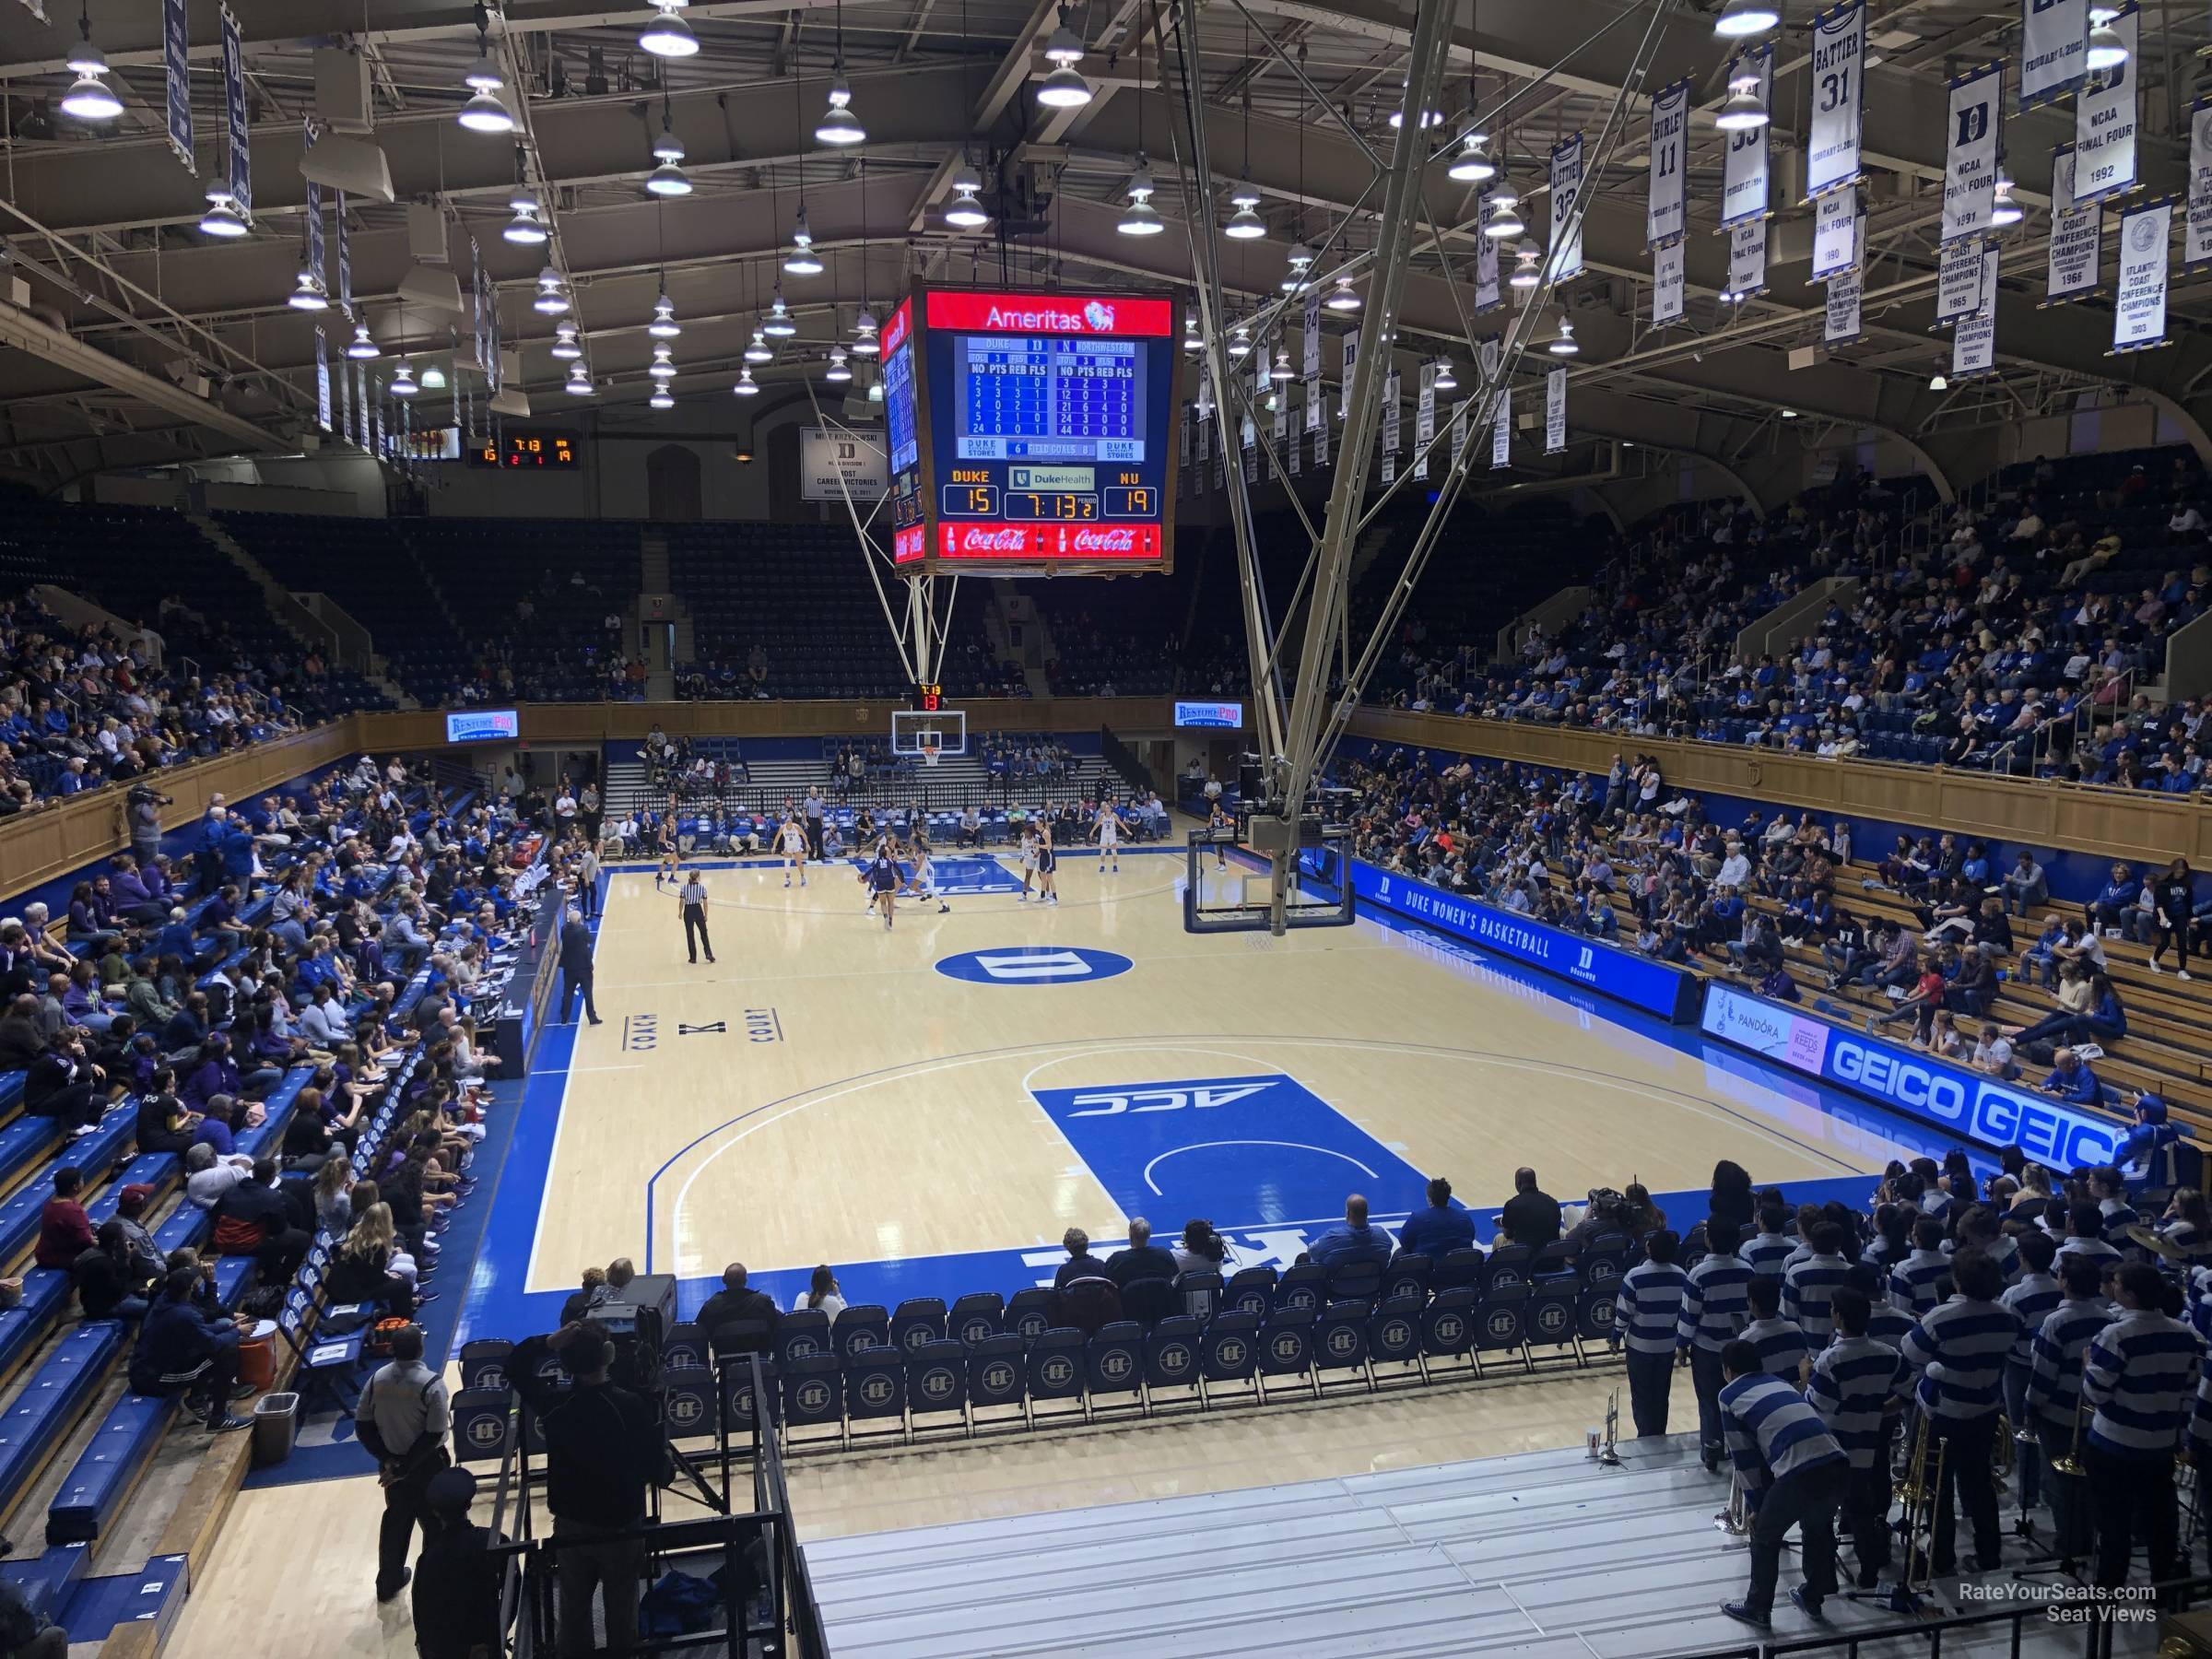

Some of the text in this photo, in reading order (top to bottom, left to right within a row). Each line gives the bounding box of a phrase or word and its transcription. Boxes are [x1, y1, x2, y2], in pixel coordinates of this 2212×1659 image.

[1816, 31, 1857, 73] BATTIER
[1821, 66, 1849, 112] 31
[2091, 107, 2117, 127] NCAA
[1653, 111, 1682, 142] HURLEY
[2078, 124, 2132, 155] FINAL FOUR
[1659, 141, 1676, 178] 11
[1959, 159, 1981, 175] NCAA
[2090, 165, 2114, 182] 1992
[1969, 174, 1992, 193] FOUR
[1831, 216, 1852, 230] FOUR
[1957, 211, 1976, 227] 1991
[2063, 216, 2087, 231] COAST
[1741, 229, 1754, 241] NCAA
[2052, 226, 2098, 246] CONFERENCE
[1747, 241, 1763, 255] FOUR
[1951, 244, 1971, 259] COAST
[2052, 240, 2095, 259] CHAMPIONS
[1941, 254, 1981, 274] CONFERENCE
[1942, 267, 1978, 285] CHAMPIONS
[2063, 272, 2082, 285] 1966
[2129, 274, 2151, 287] COAST
[2121, 284, 2163, 300] CONFERENCE
[1949, 296, 1966, 309] 1965
[2122, 296, 2160, 312] CHAMPIONS
[1958, 318, 1993, 334] CONFERENCE
[986, 339, 1010, 348] DUKE
[1958, 330, 1991, 344] CHAMPIONS
[972, 364, 1045, 375] NO PTS REB FLS
[1061, 367, 1132, 378] NO PTS REB FLS
[975, 376, 981, 385] 2
[995, 376, 1001, 386] 2
[1035, 378, 1040, 387] 0
[1064, 379, 1068, 387] 3
[1083, 380, 1088, 388] 2
[1102, 380, 1108, 389] 3
[975, 388, 981, 397] 3
[995, 389, 1001, 397] 3
[1015, 389, 1020, 398] 3
[1063, 391, 1070, 399] 12
[1083, 391, 1088, 400] 0
[1121, 392, 1126, 401] 2
[975, 400, 981, 409] 4
[995, 401, 1001, 409] 0
[1015, 401, 1020, 410] 2
[1063, 402, 1126, 412] 21 6 4 0
[975, 412, 981, 421] 5
[995, 412, 1001, 421] 2
[1035, 413, 1040, 422] 0
[1061, 414, 1126, 424] 24 3 0 0
[973, 424, 984, 432] 24
[995, 424, 1001, 433] 0
[1015, 424, 1020, 433] 0
[1061, 426, 1126, 435] 44 0 0 0
[515, 440, 540, 452] 7:13
[1015, 444, 1020, 453] 6
[1028, 444, 1048, 453] FIELD
[1083, 445, 1088, 454] 8
[512, 456, 518, 465] 2
[559, 451, 570, 461] 19
[952, 470, 989, 483] DUKE
[1034, 474, 1090, 484] DukeHealth
[1121, 473, 1139, 484] NU
[970, 488, 989, 512] 15
[1028, 495, 1076, 519] 7:13
[1128, 490, 1147, 512] 19
[1083, 504, 1091, 516] 2
[922, 686, 940, 695] 7:13
[925, 696, 936, 711] 13
[1406, 890, 1430, 912] DUKE
[1432, 900, 1477, 930] WOMEN'S
[1480, 918, 1548, 958] BASKETBALL
[631, 1014, 657, 1050] COACH
[744, 1008, 774, 1042] COURT
[1738, 1014, 1779, 1039] PANDORA
[1794, 1033, 1818, 1052] REEDS
[1833, 1041, 1964, 1119] GEICO
[1066, 1082, 1281, 1117] ACC
